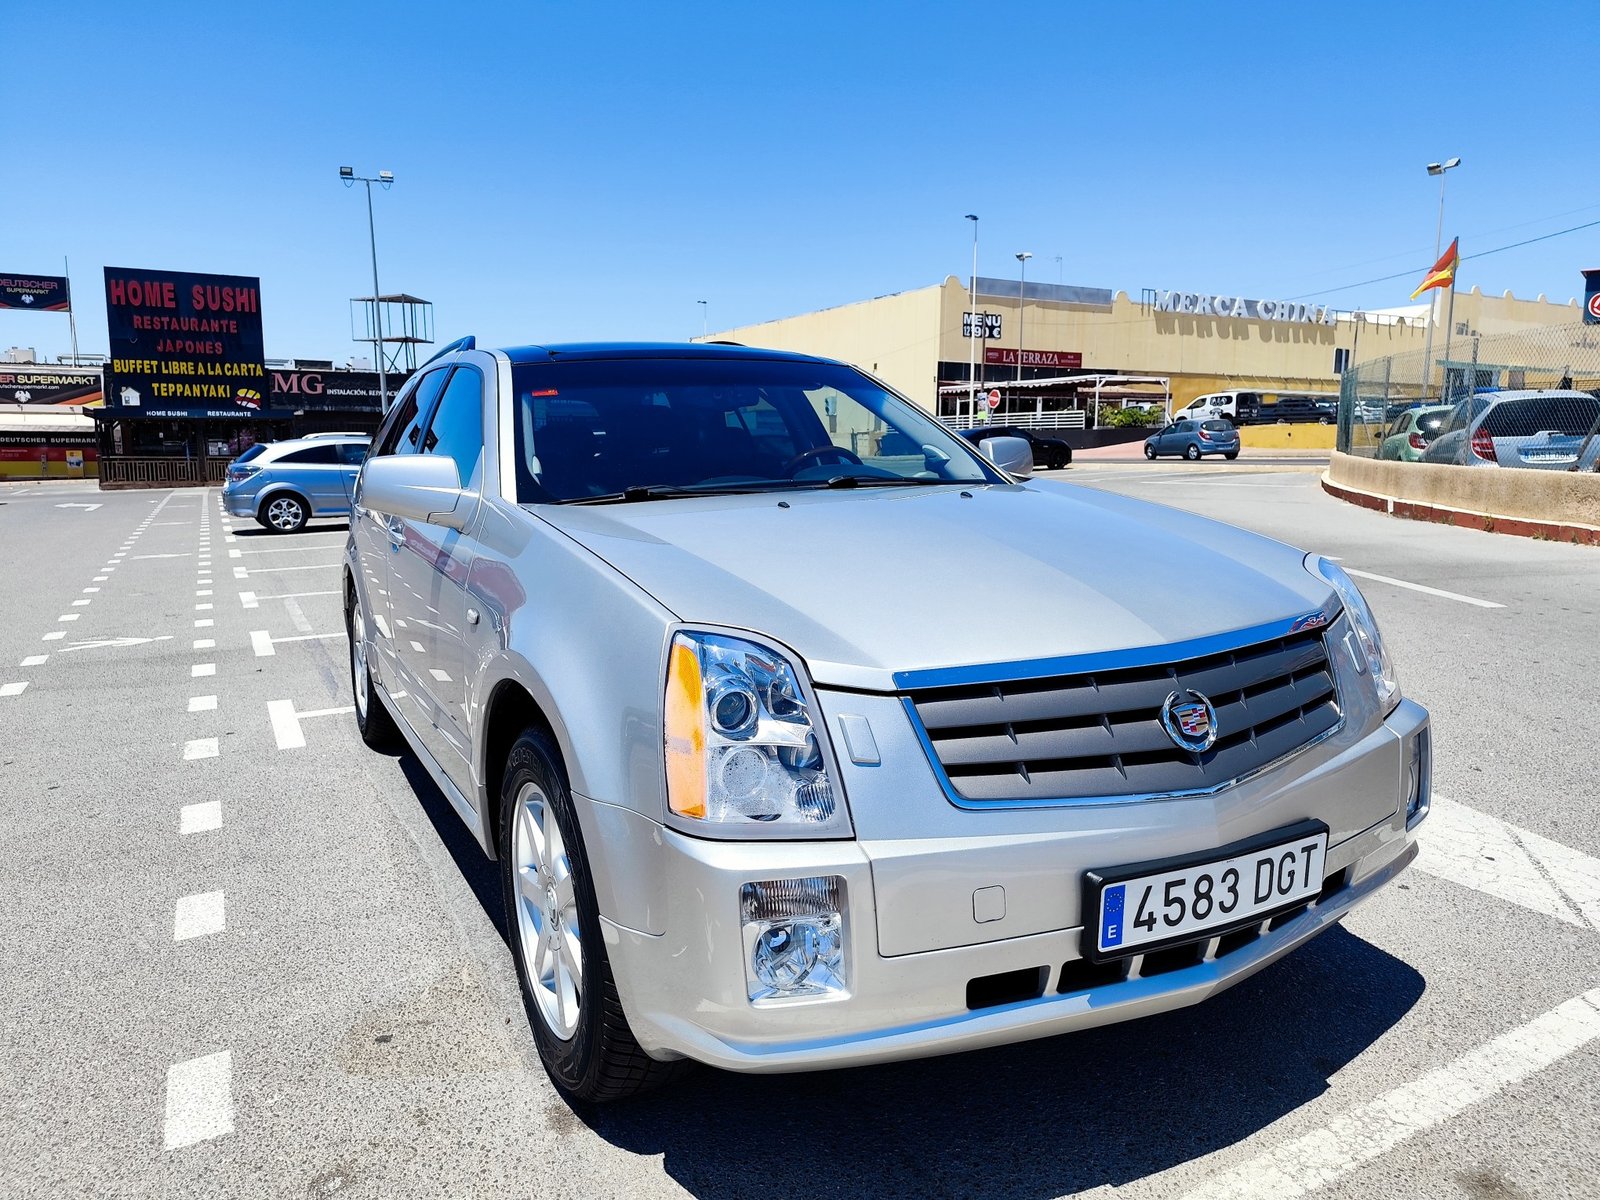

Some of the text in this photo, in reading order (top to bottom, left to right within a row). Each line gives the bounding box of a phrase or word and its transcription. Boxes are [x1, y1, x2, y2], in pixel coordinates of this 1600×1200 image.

[110, 279, 257, 313] HOME SUSHI
[1154, 290, 1335, 326] MERCA CHINA
[133, 314, 238, 334] RESTAURANTE
[992, 328, 1000, 338] €
[156, 339, 223, 355] JAPONES
[1002, 350, 1014, 362] LA
[113, 359, 264, 377] BUFFET LIBRE A LA CARTA
[17, 375, 95, 385] SUPERMARKT
[271, 372, 325, 395] MG
[152, 383, 230, 398] TEPPANYAKI
[1133, 844, 1318, 932] 4583 DGT
[1108, 924, 1117, 938] E
